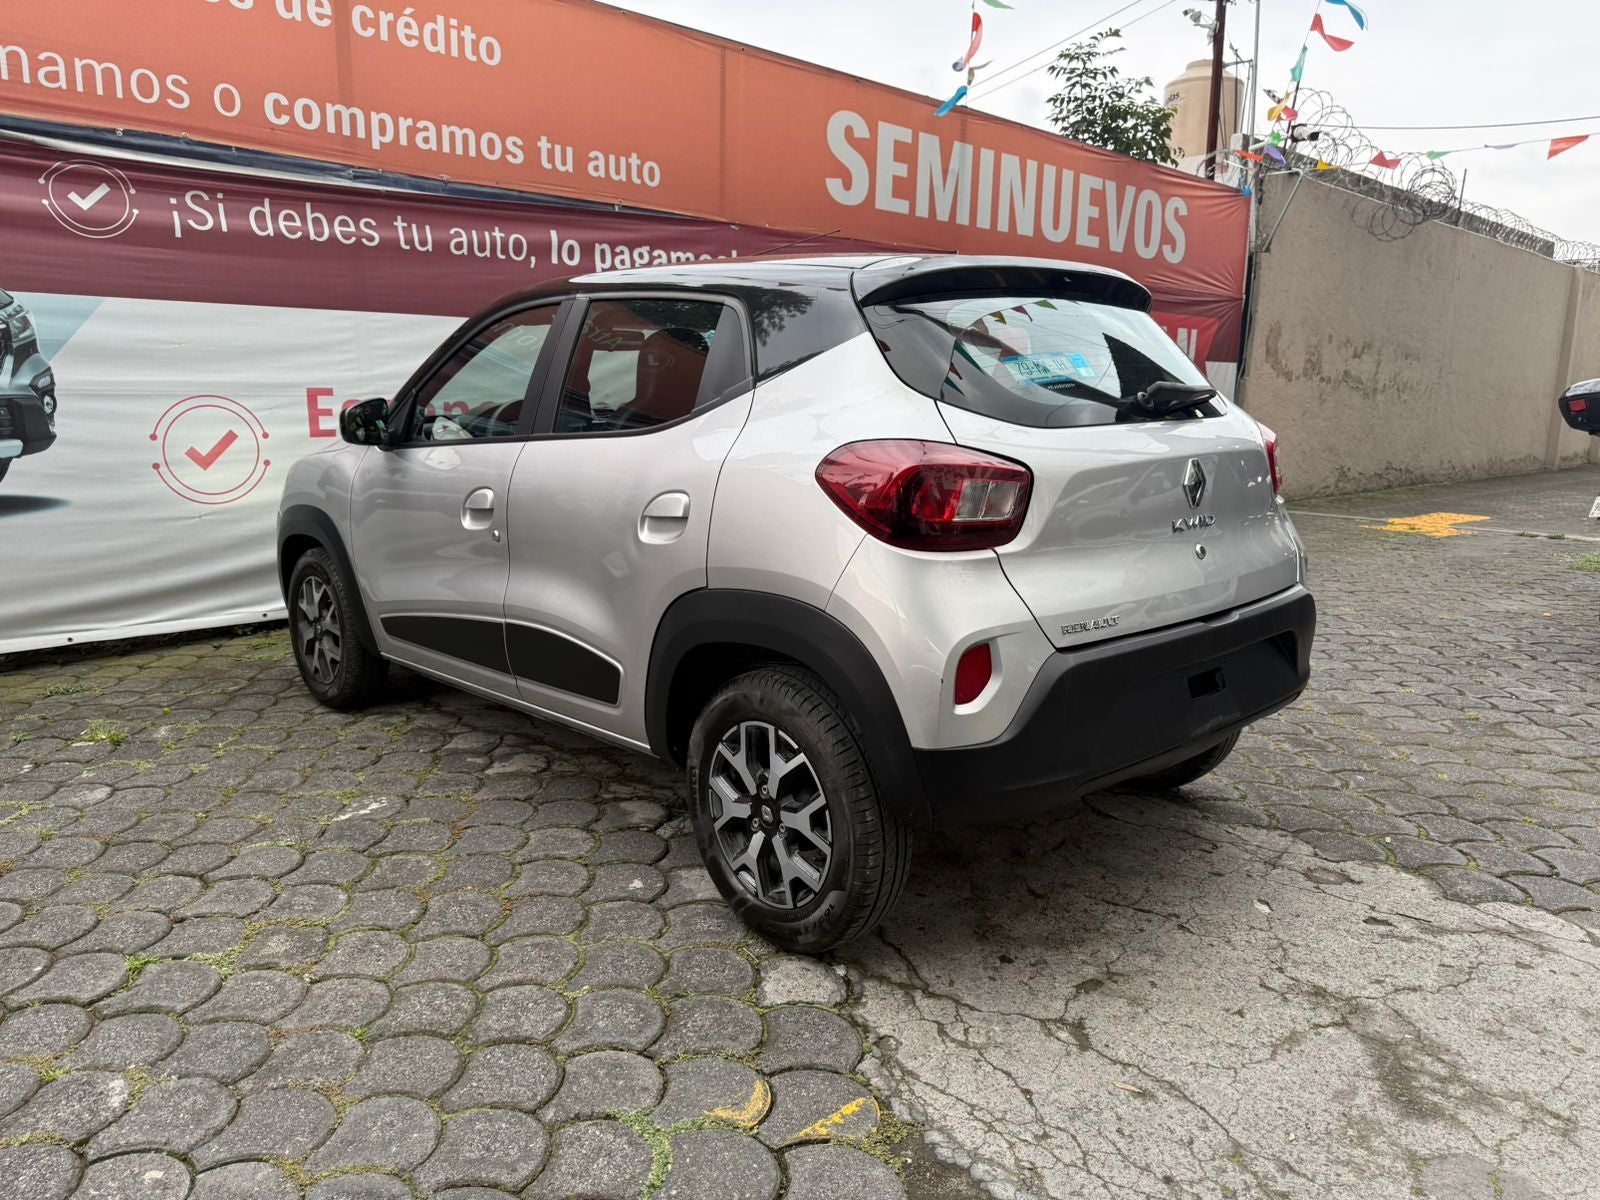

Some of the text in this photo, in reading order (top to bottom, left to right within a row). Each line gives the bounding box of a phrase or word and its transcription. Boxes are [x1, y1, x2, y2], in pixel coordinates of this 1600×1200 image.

[351, 4, 502, 66] crédito
[213, 82, 242, 118] o
[263, 91, 525, 165] compramos
[537, 135, 574, 173] tu
[587, 149, 661, 188] auto
[824, 109, 1189, 264] SEMINUEVOS
[169, 189, 229, 238] ¡Si
[249, 198, 381, 247] debes
[393, 215, 434, 252] tu
[449, 225, 537, 269] auto,
[550, 229, 581, 267] lo
[1171, 514, 1216, 534] KWID
[1061, 615, 1120, 635] RENAULT
